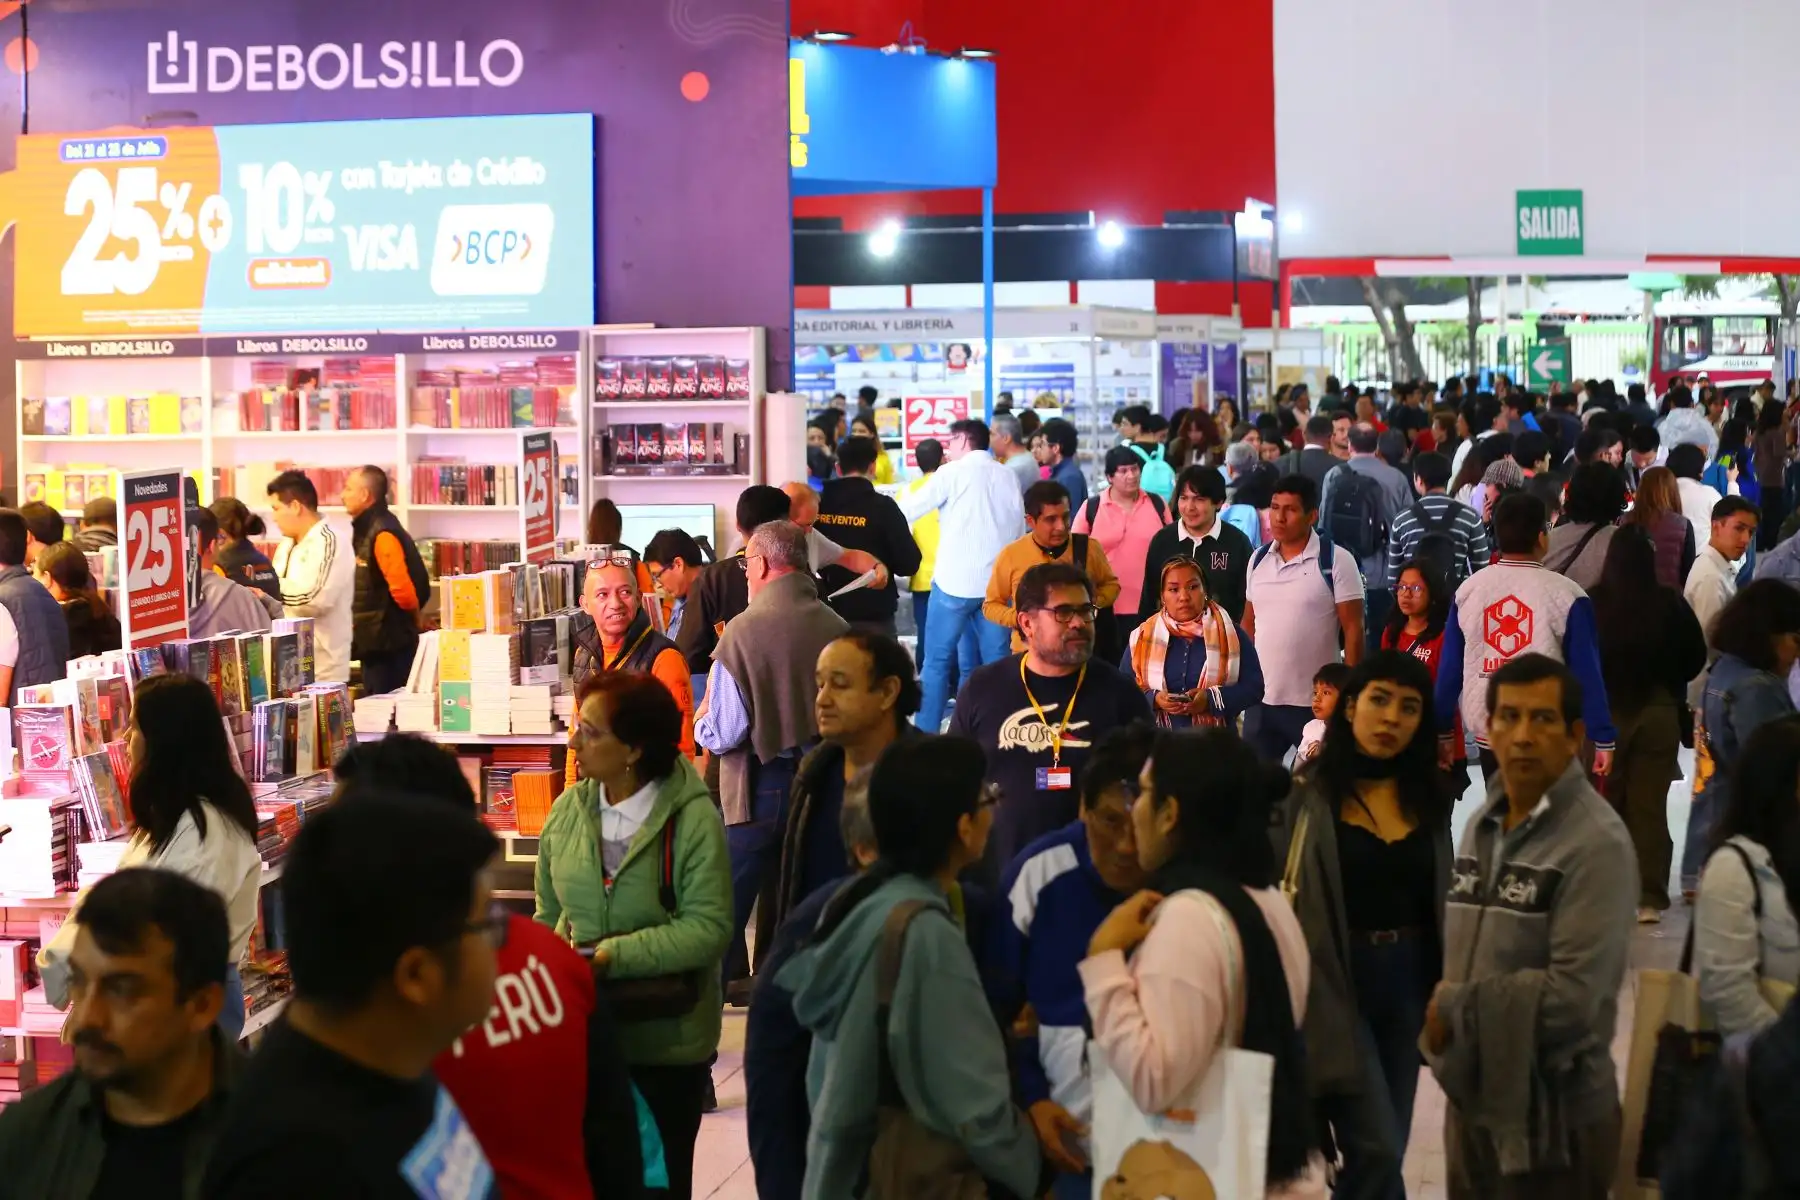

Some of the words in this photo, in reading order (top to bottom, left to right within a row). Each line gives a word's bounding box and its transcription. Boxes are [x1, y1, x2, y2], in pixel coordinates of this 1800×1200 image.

[1519, 206, 1581, 239] SALIDA
[340, 220, 420, 271] VISA
[465, 230, 518, 265] BCP
[812, 319, 878, 332] EDITORIAL
[882, 319, 891, 331] Y
[894, 316, 954, 331] LIBRERÍA
[46, 342, 87, 357] Libros
[90, 340, 175, 356] DEBOLSILLO
[236, 339, 278, 354] Libros
[282, 337, 368, 353] DEBOLSILLO
[422, 336, 465, 350] Libros
[469, 334, 557, 350] DEBOLSILLO
[134, 482, 169, 497] Novedades
[1210, 551, 1229, 571] W
